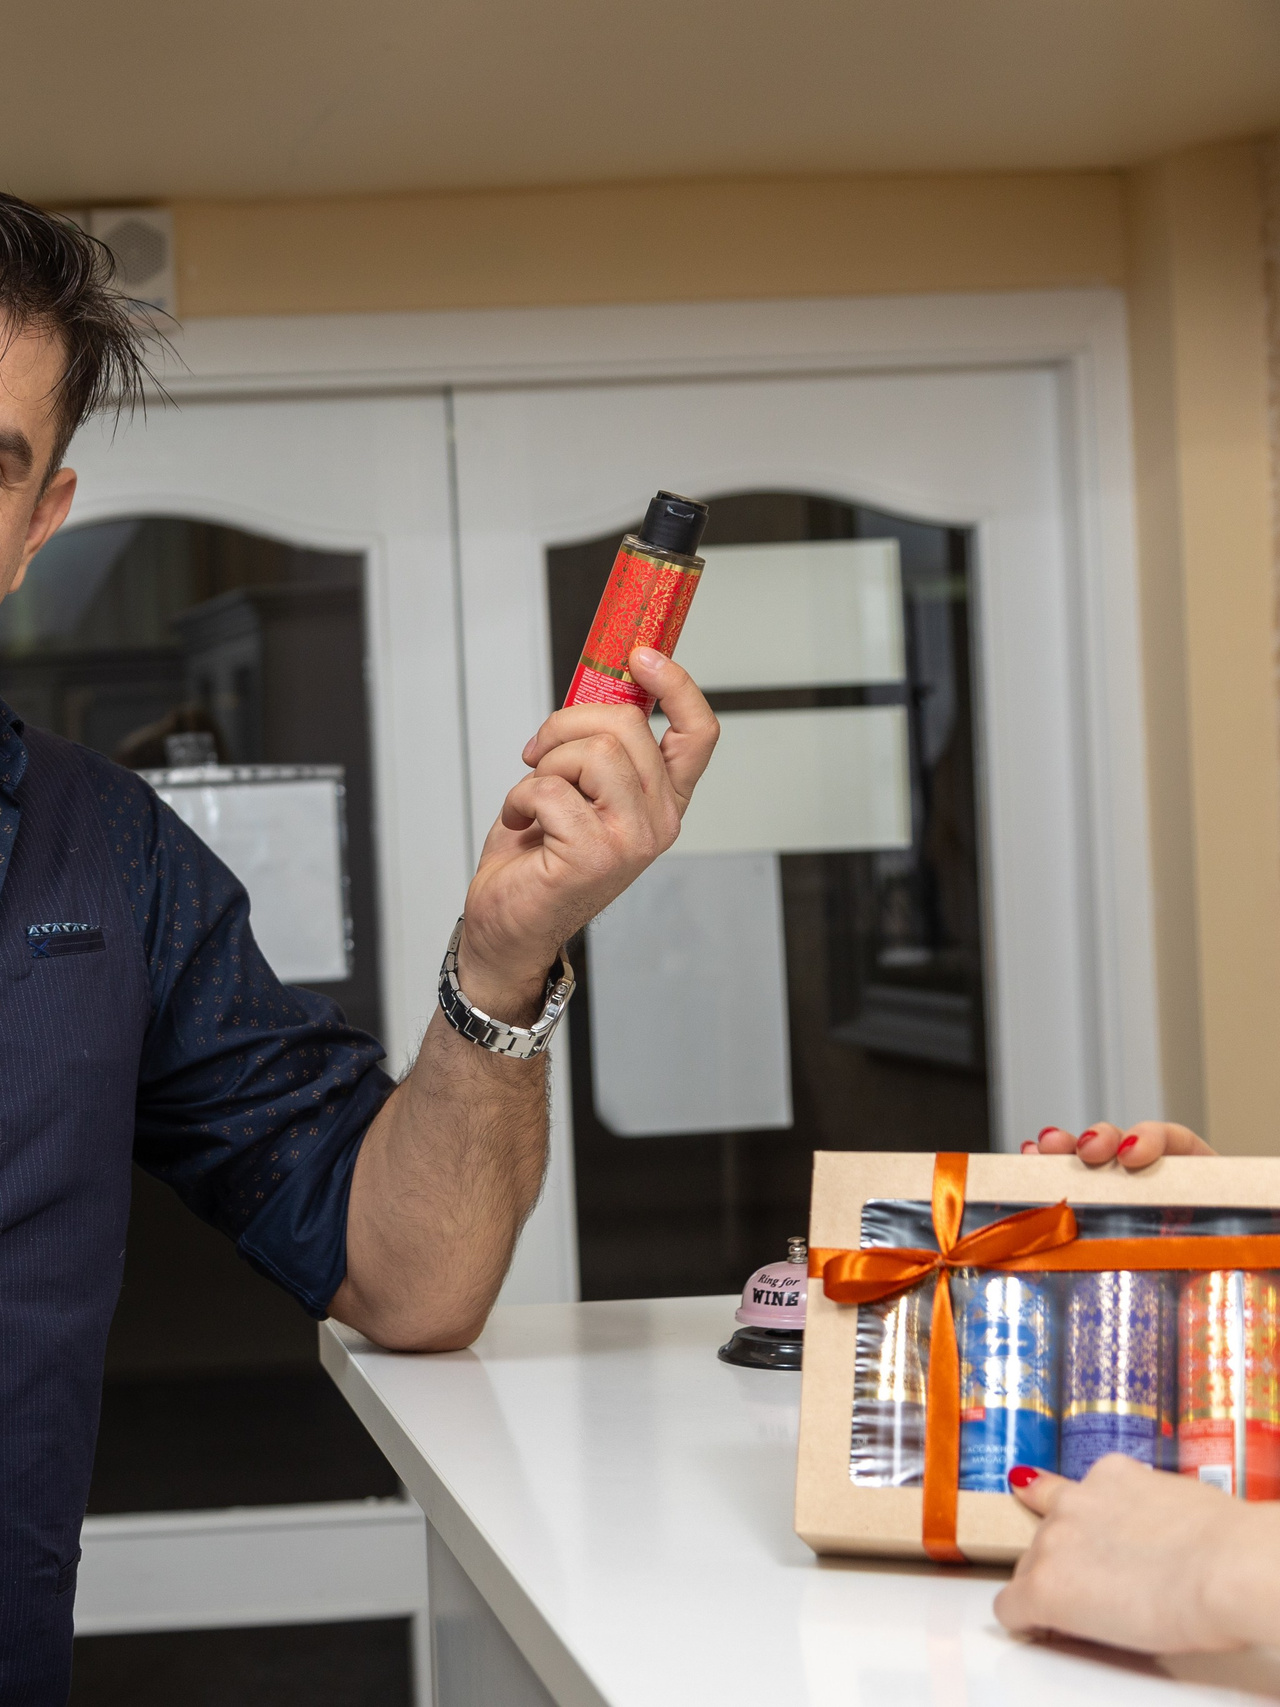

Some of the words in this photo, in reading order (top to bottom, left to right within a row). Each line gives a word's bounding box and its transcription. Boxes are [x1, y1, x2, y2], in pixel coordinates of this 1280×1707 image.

[758, 1274, 779, 1287] Ring
[778, 1277, 800, 1288] for
[752, 1287, 800, 1307] WINE
